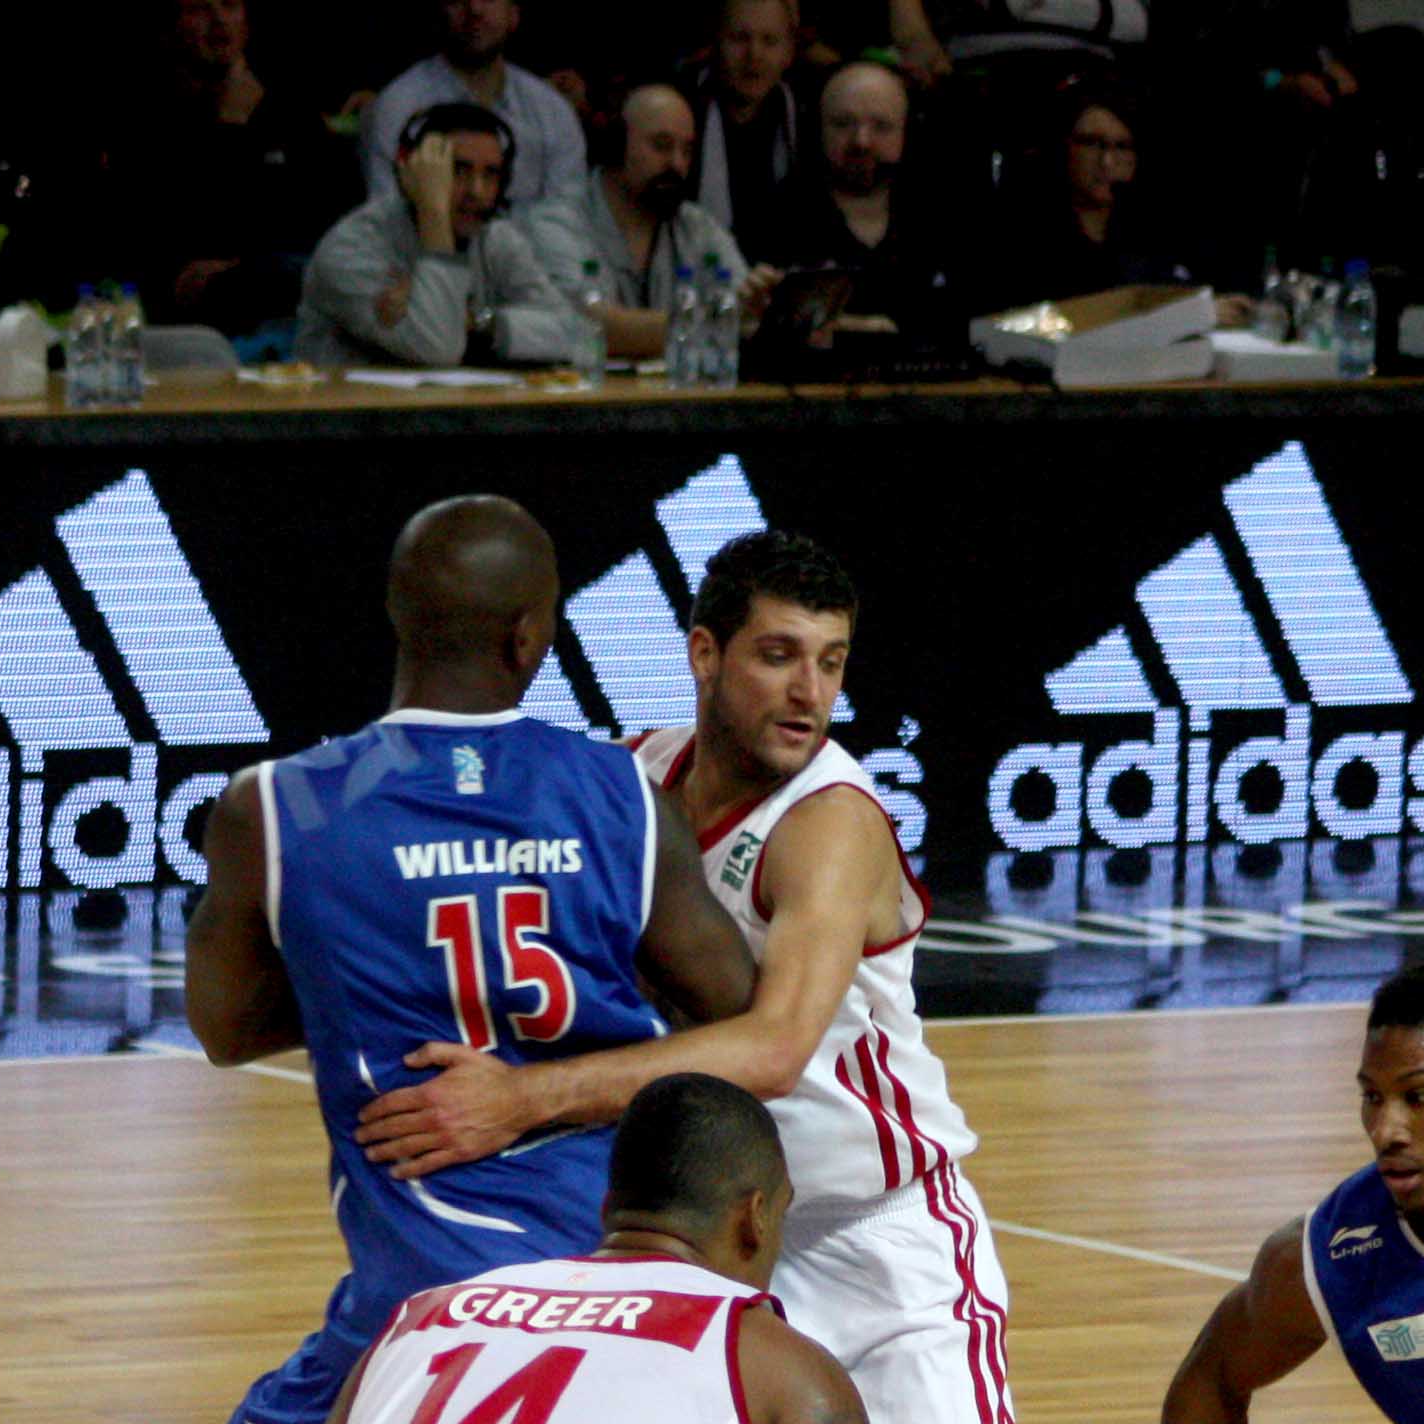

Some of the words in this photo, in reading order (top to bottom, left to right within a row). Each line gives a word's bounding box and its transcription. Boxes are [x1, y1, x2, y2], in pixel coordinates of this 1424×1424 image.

[393, 838, 584, 881] WILLIAMS
[426, 884, 577, 1053] 15
[448, 1286, 654, 1332] GREER
